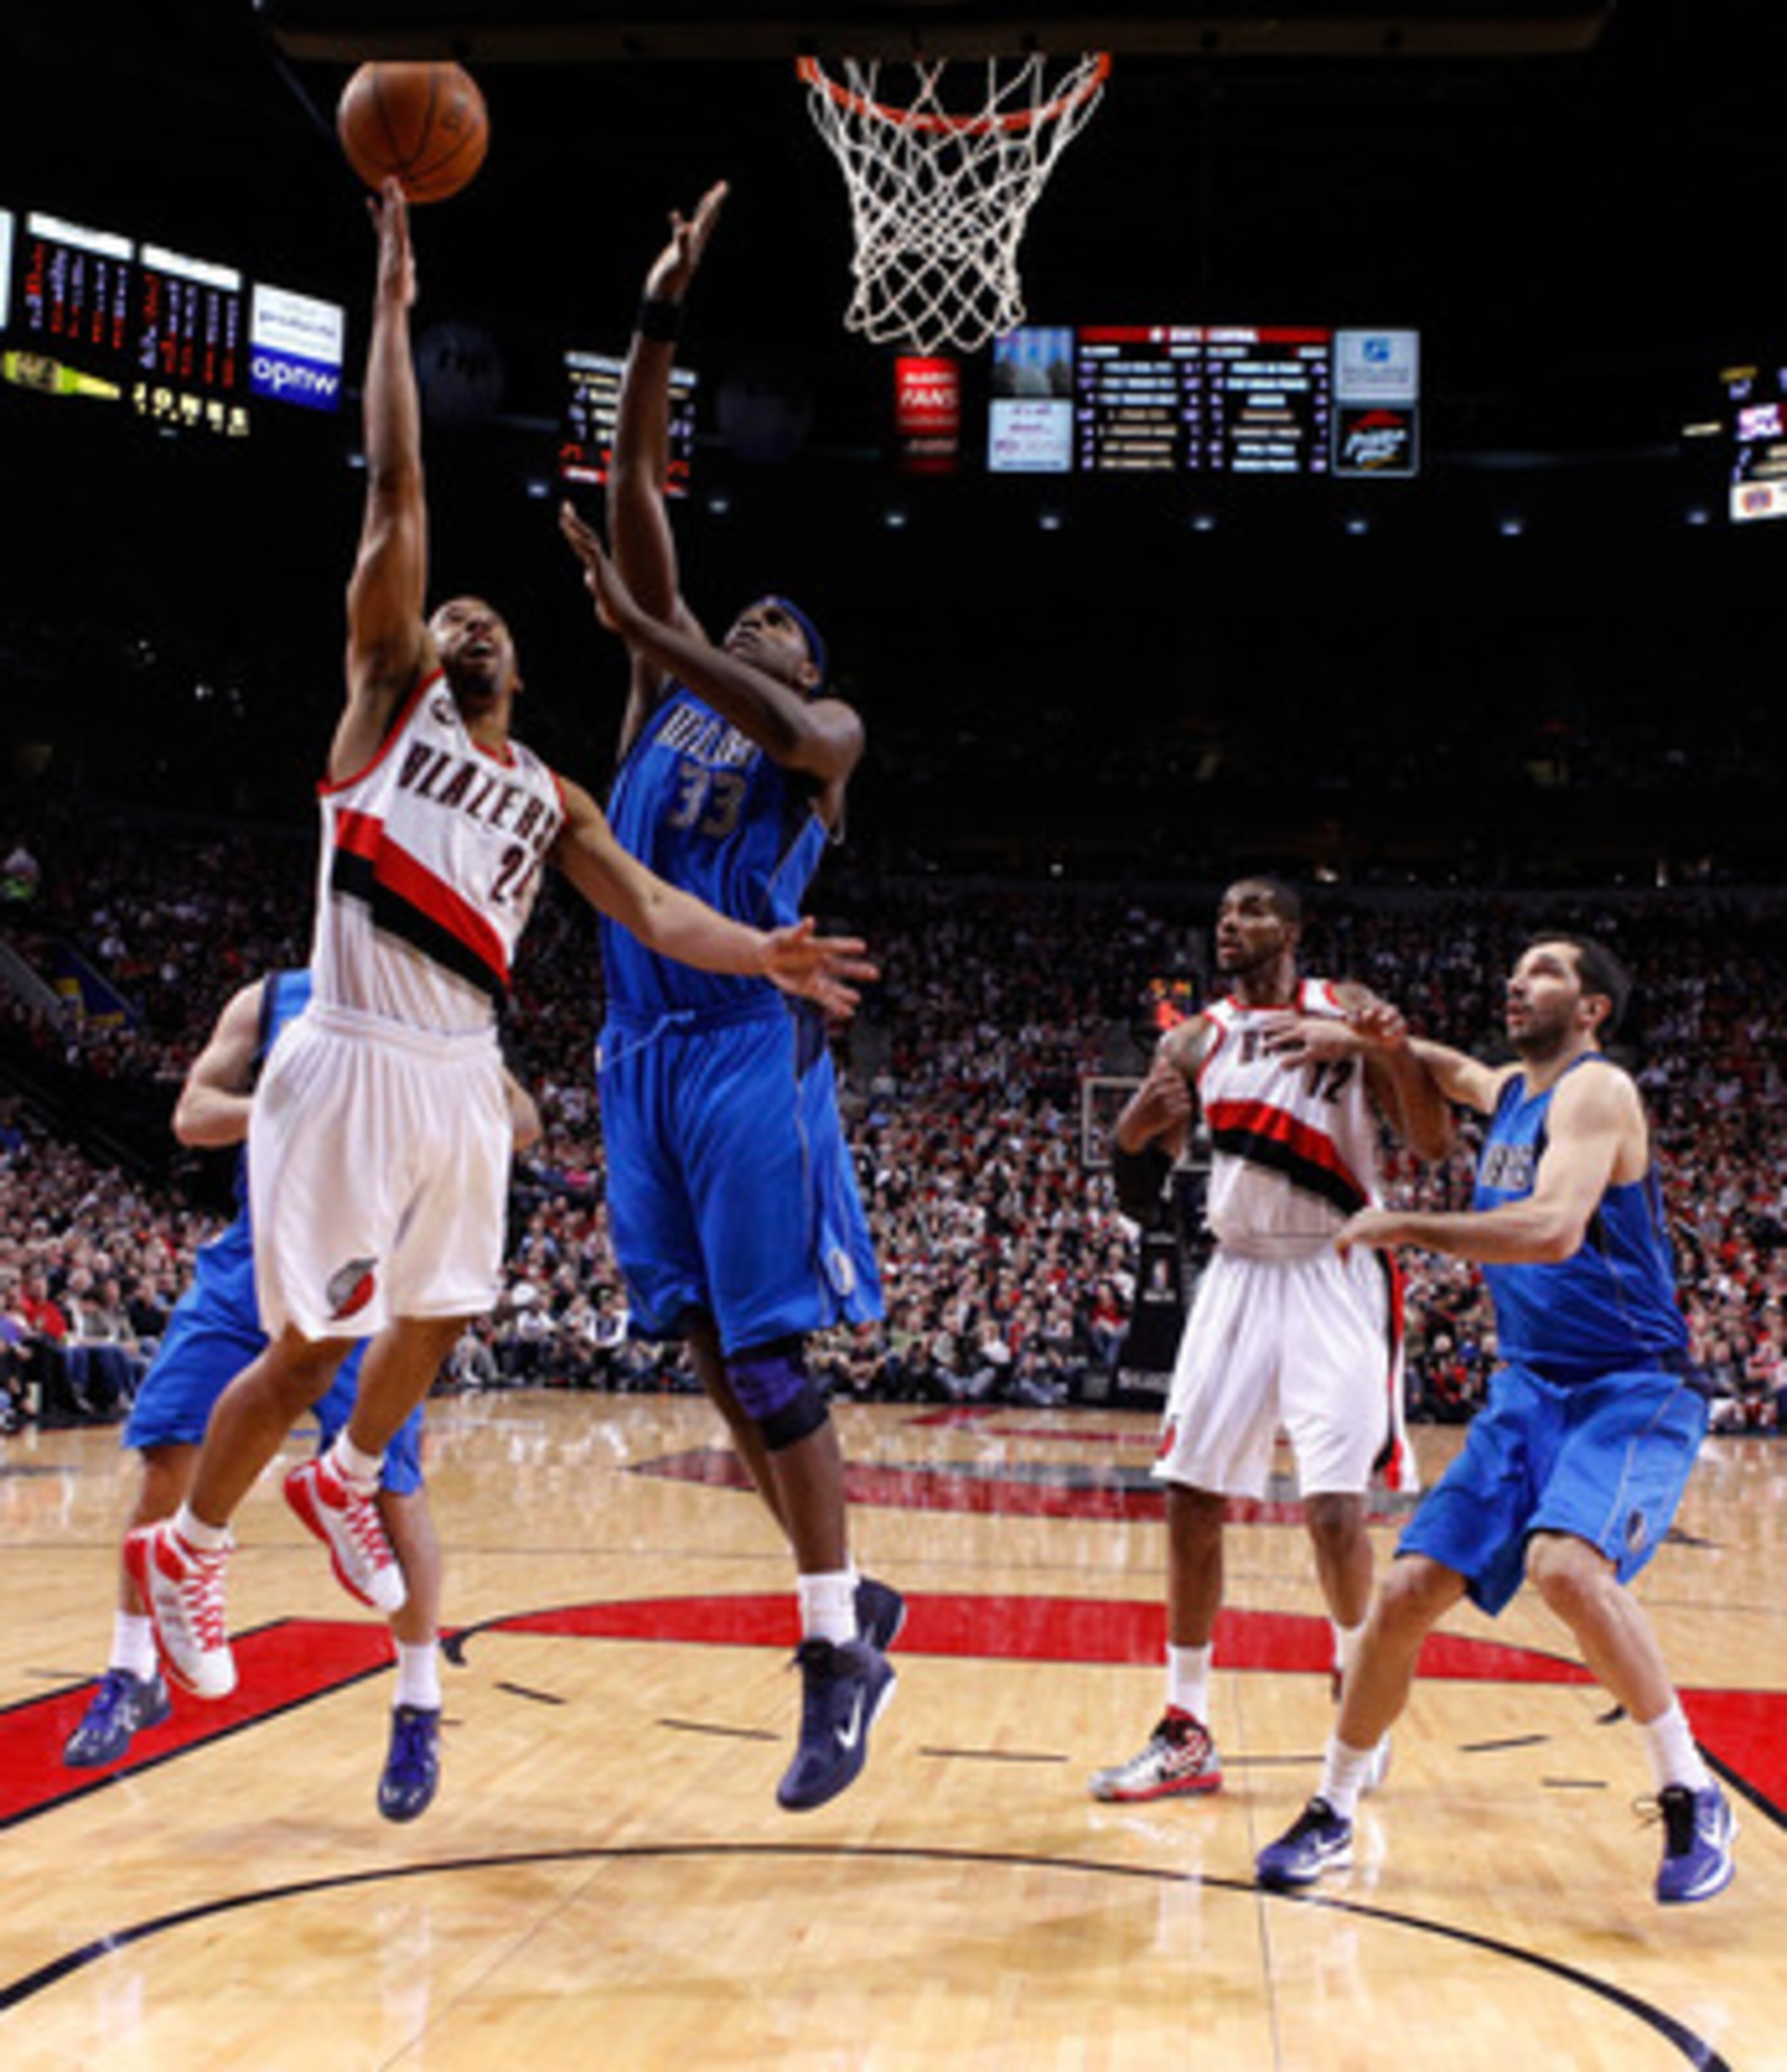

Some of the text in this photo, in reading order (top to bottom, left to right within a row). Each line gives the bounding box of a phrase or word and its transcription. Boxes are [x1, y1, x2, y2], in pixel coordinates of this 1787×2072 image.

[398, 741, 558, 853] BLAZERS
[670, 762, 746, 837] 33
[1306, 1059, 1355, 1105] 12
